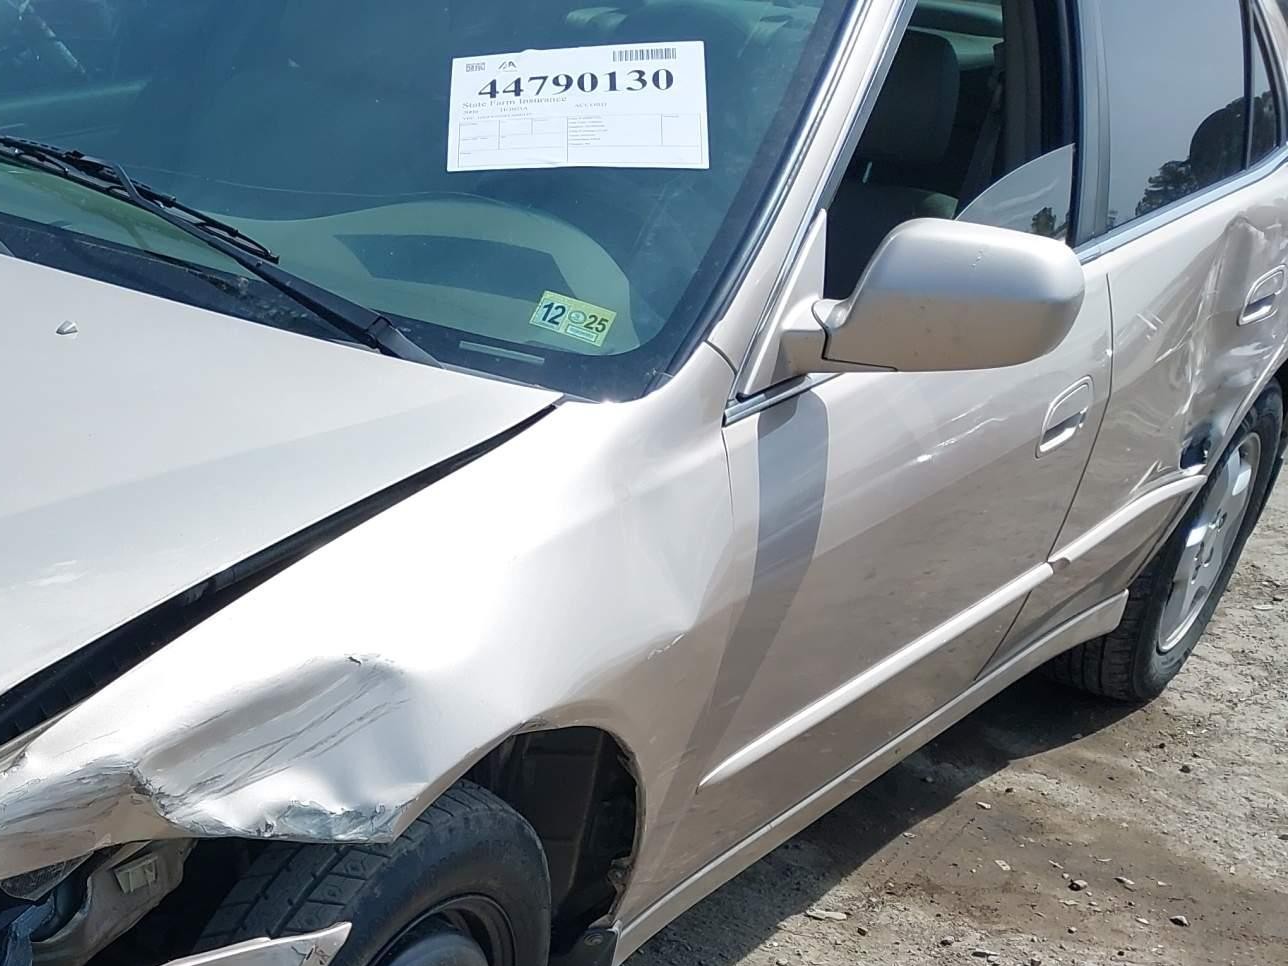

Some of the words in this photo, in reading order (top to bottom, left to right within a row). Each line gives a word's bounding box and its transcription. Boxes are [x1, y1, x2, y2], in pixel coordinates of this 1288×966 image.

[478, 69, 674, 99] 44790130
[542, 302, 566, 325] 12
[584, 315, 609, 333] 25
